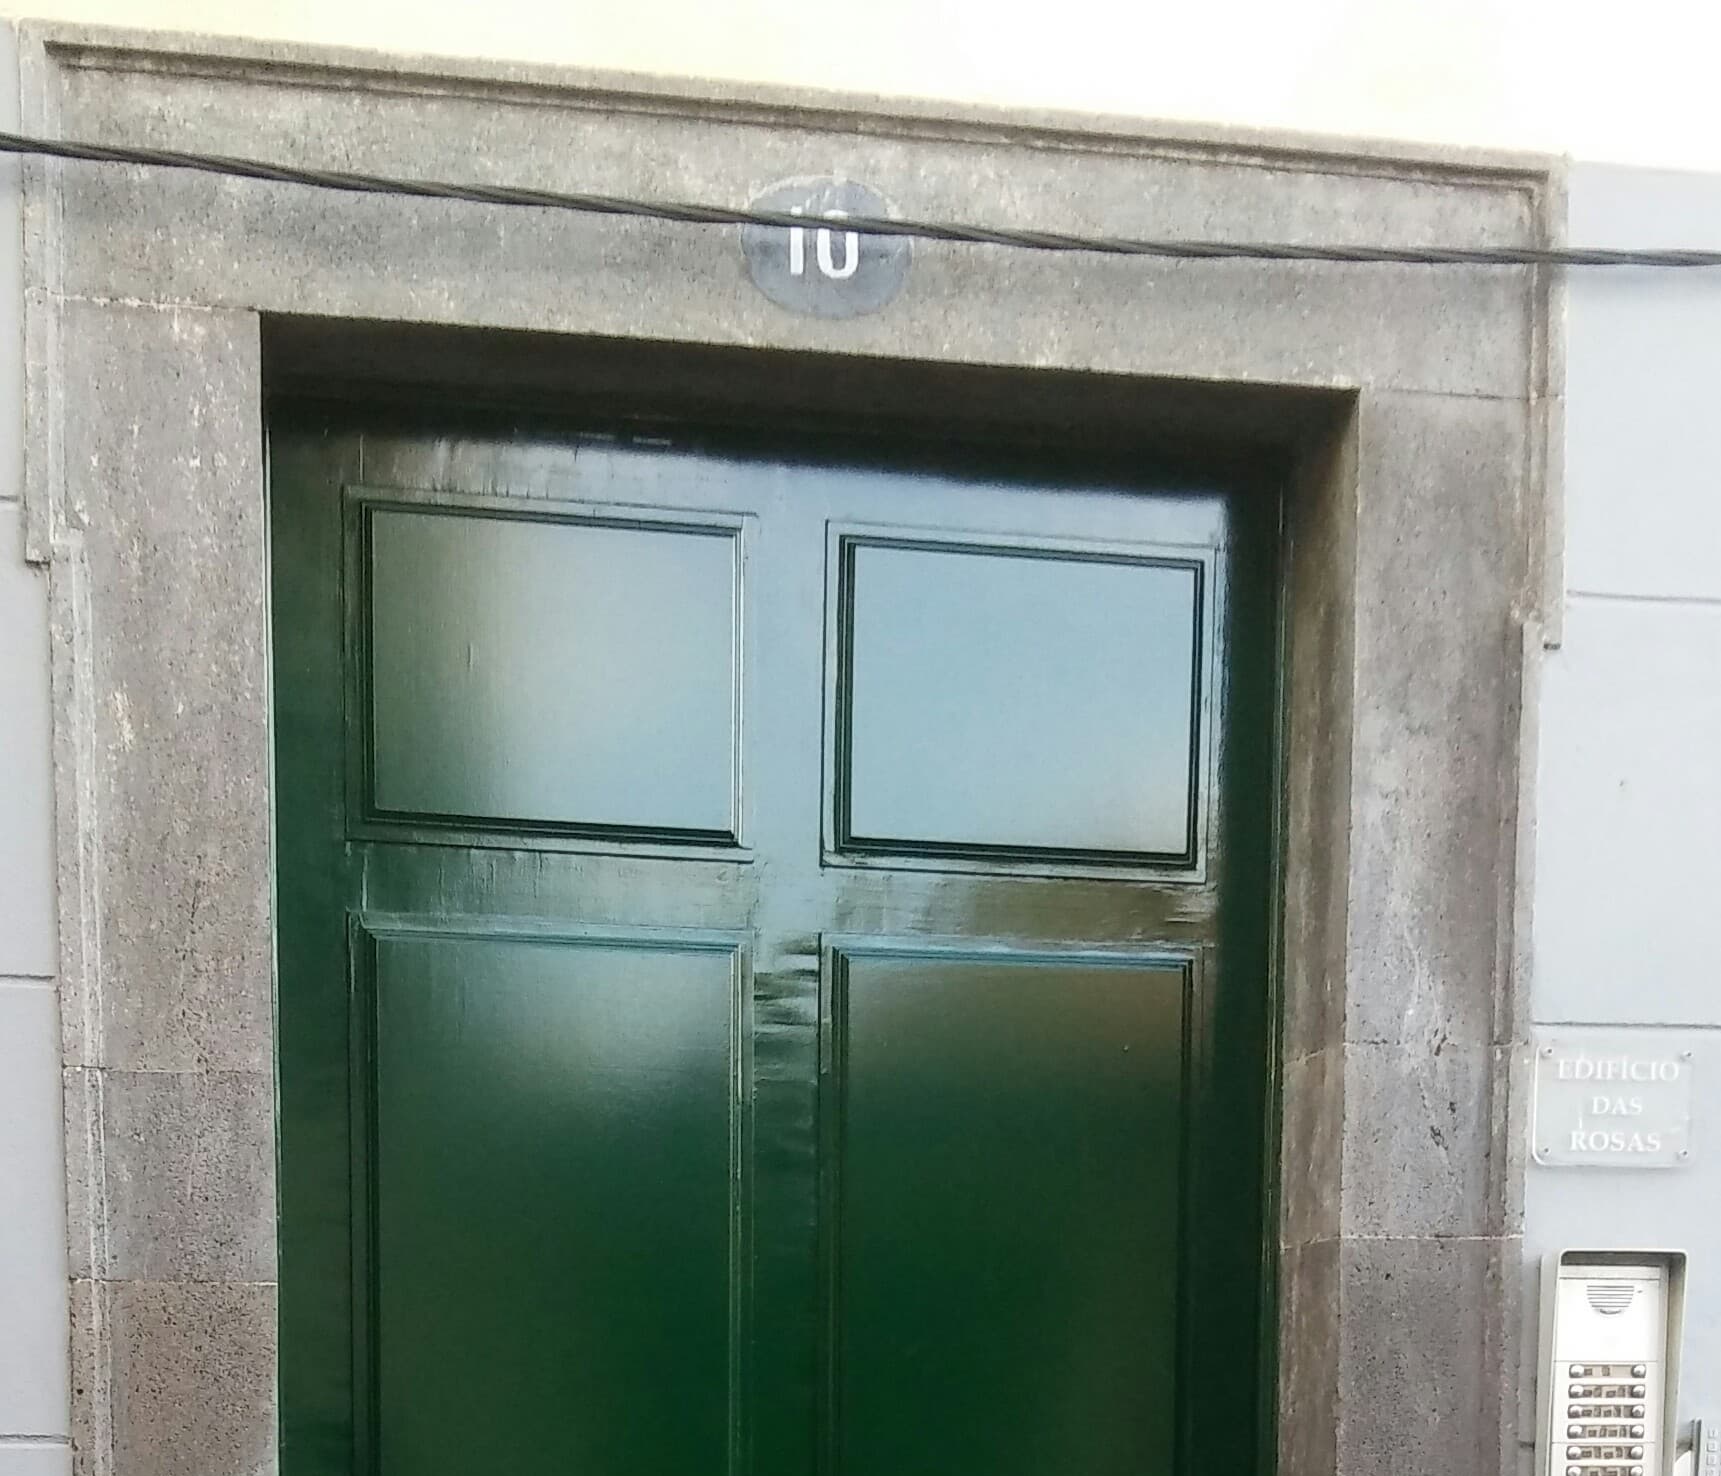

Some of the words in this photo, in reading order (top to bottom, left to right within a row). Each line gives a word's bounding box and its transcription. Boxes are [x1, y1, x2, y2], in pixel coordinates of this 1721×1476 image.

[790, 206, 859, 279] 10
[1591, 1096, 1643, 1115] DAS
[1570, 1129, 1662, 1152] ROSAS
